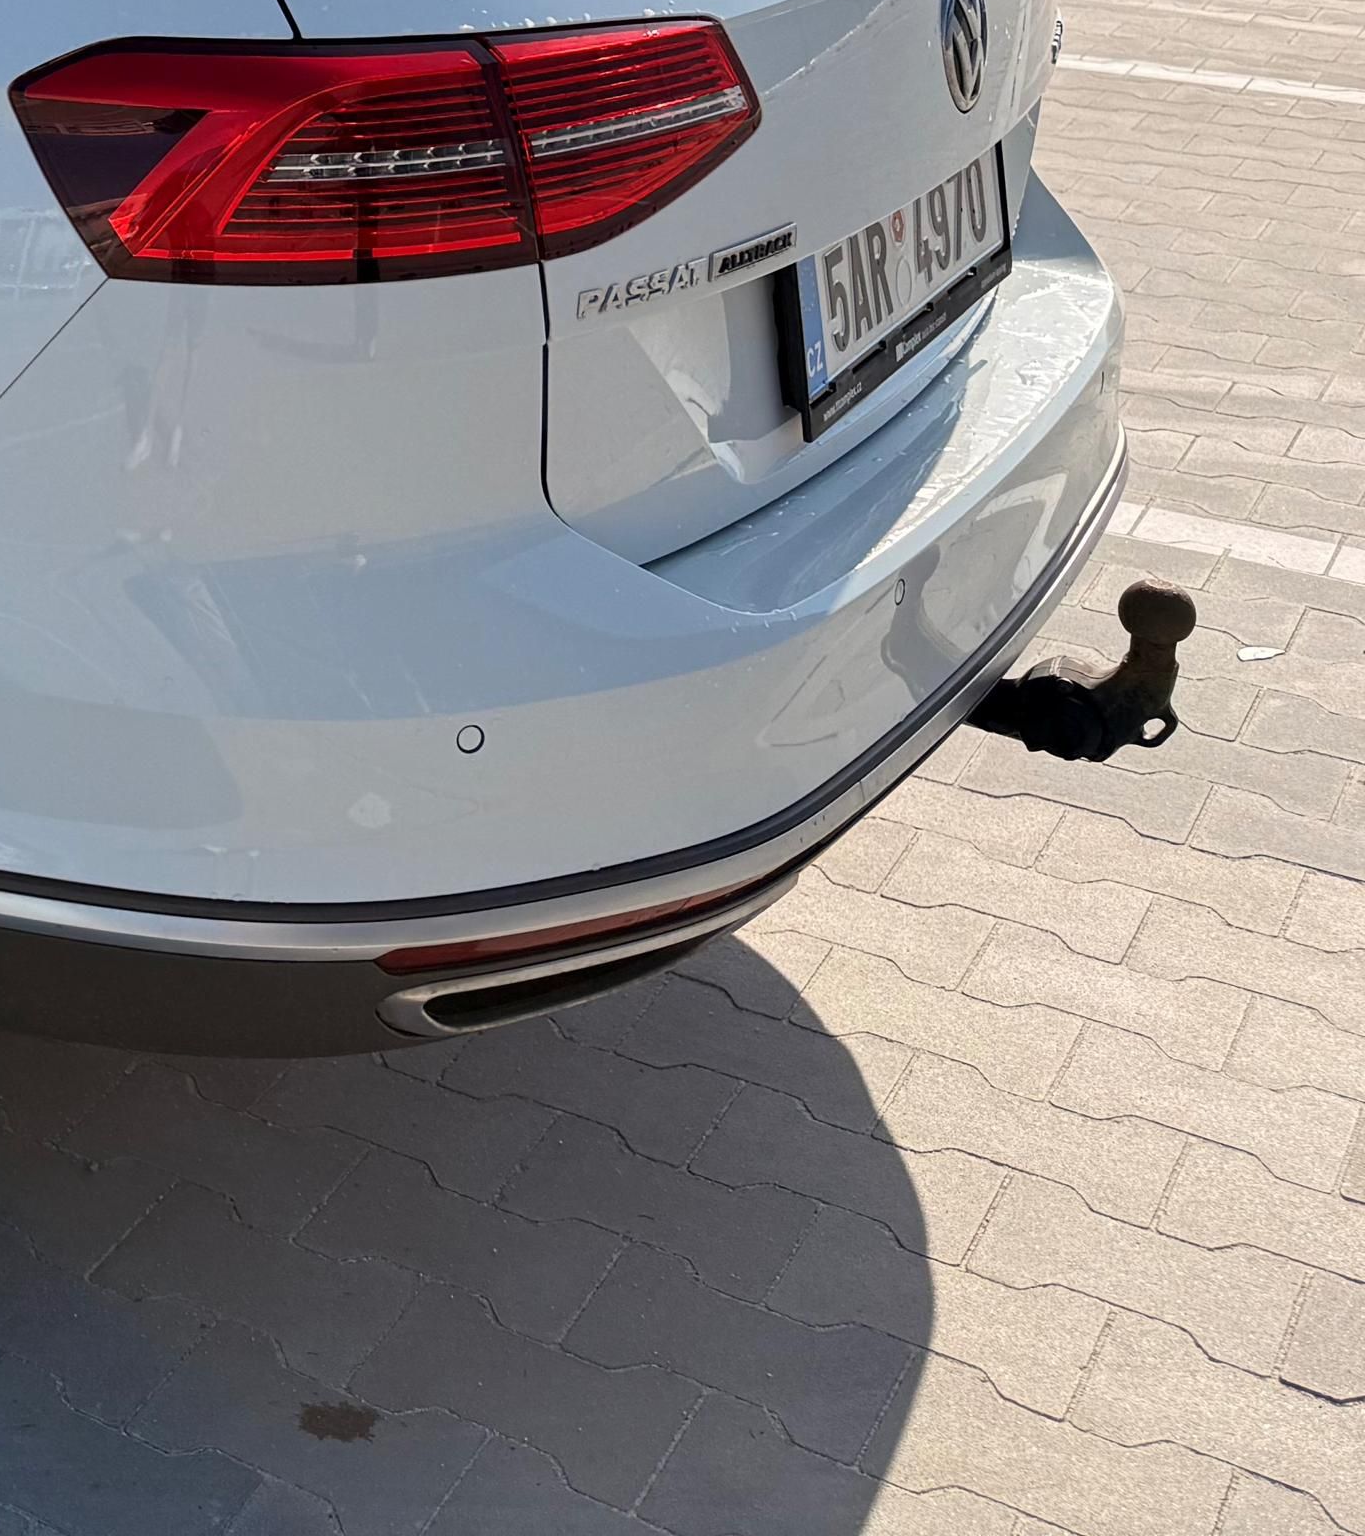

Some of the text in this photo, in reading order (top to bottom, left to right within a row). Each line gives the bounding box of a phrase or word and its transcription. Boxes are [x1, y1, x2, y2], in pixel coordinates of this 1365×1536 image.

[823, 158, 987, 352] 5AR 4970
[577, 257, 707, 319] PASSAT
[807, 340, 823, 378] CZ
